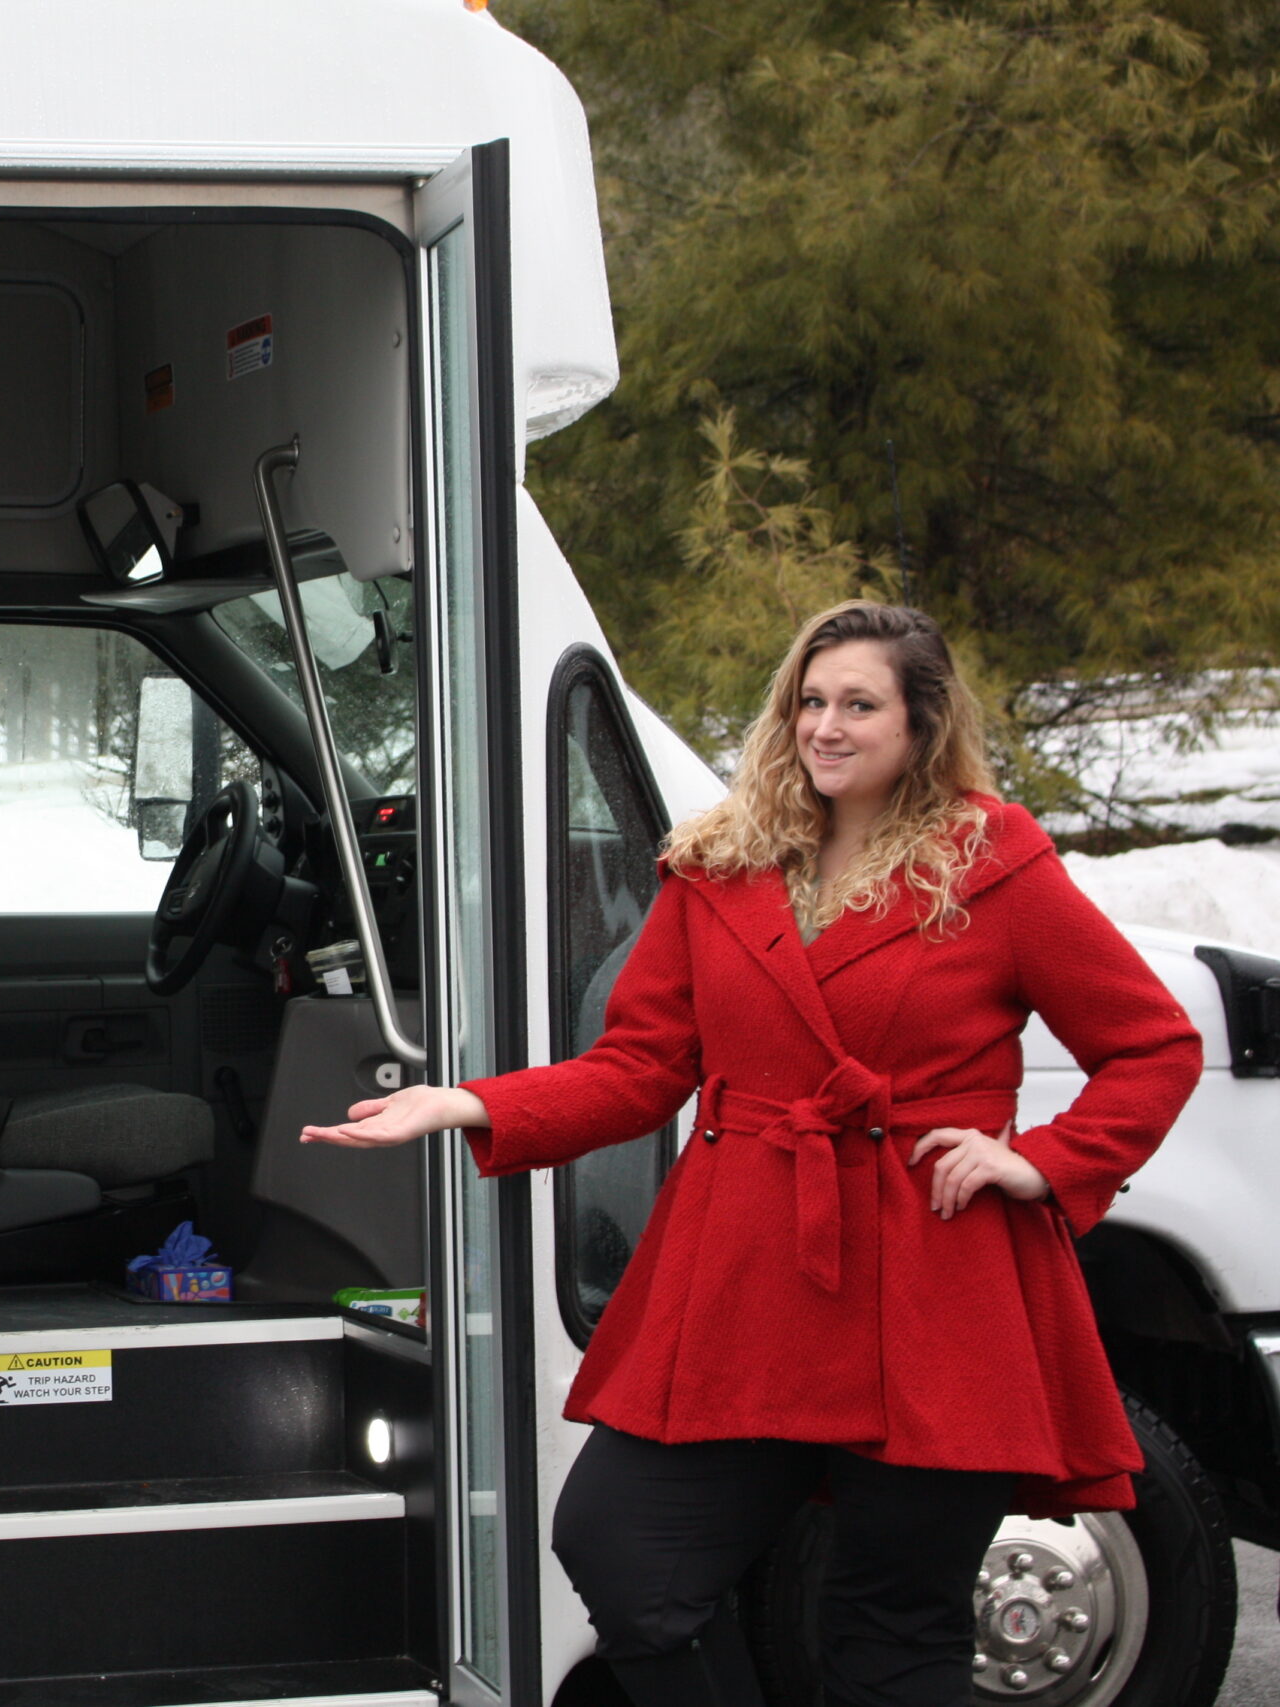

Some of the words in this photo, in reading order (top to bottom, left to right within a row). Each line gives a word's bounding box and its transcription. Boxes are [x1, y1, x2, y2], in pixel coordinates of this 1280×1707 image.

[26, 1356, 83, 1368] CAUTION
[28, 1376, 51, 1385] TRIP
[53, 1374, 96, 1384] HAZARD
[13, 1388, 50, 1398] WATCH
[52, 1387, 81, 1396] YOUR
[85, 1386, 111, 1395] STEP
